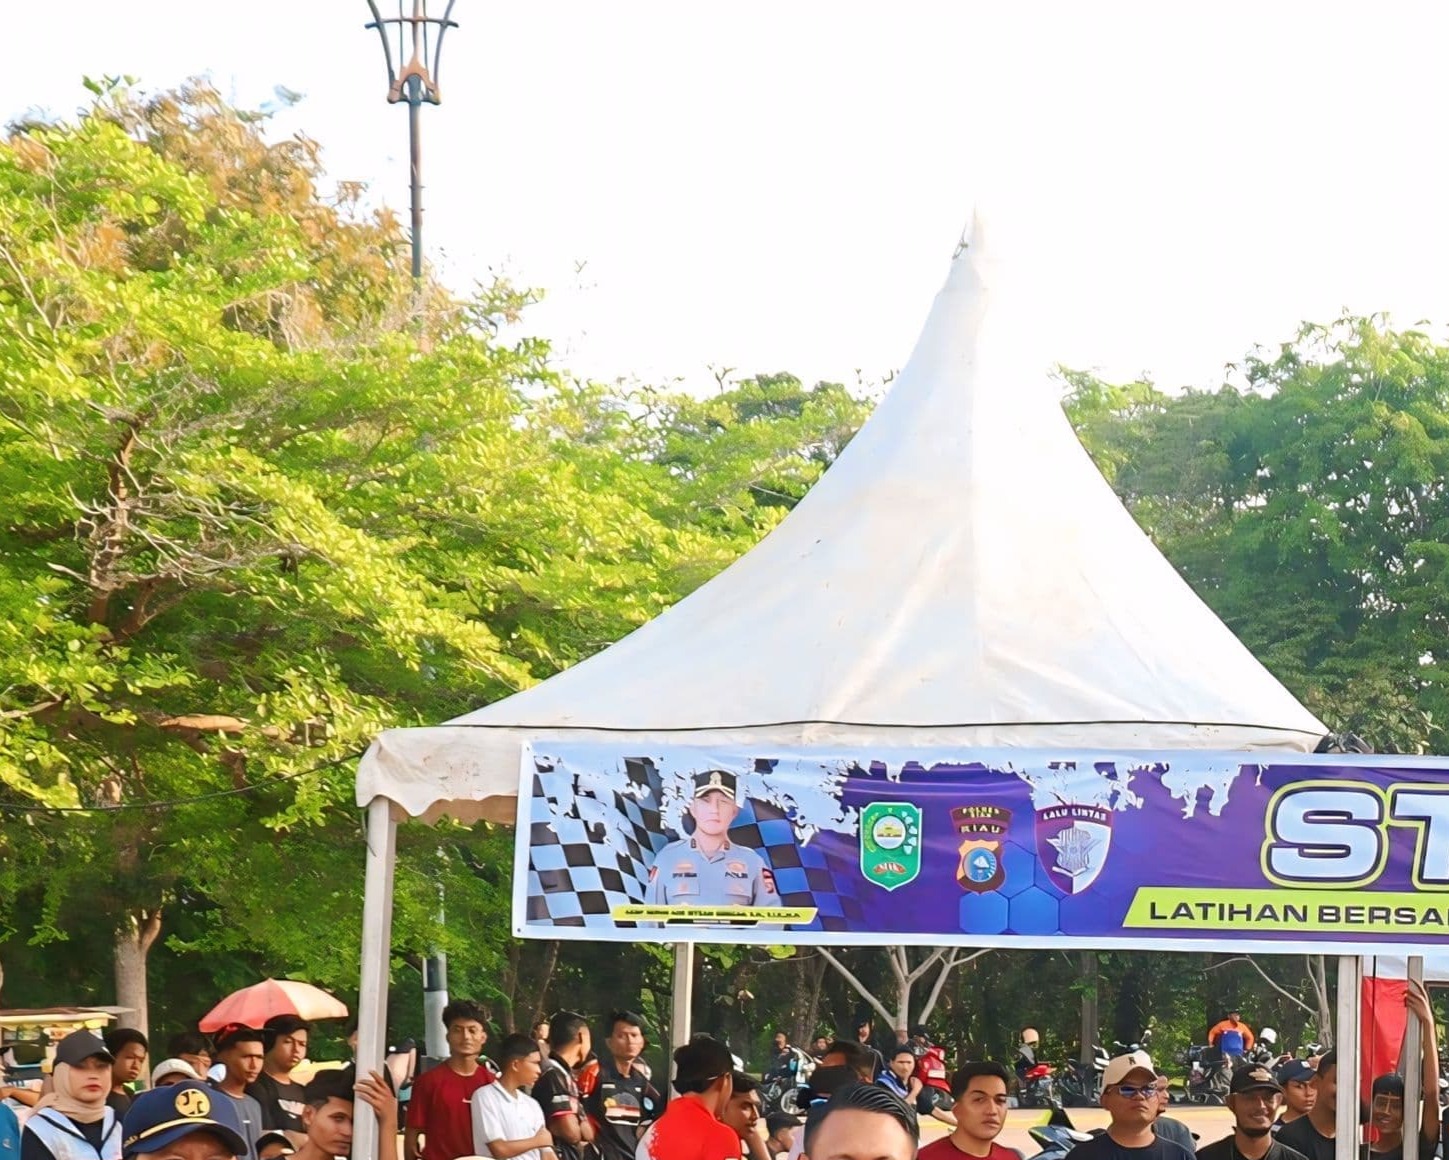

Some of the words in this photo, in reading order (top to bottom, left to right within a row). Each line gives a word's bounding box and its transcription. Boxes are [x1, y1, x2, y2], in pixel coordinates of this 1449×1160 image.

[1043, 807, 1068, 820] LALU
[1072, 807, 1107, 820] LINTAS
[960, 824, 1000, 834] RIAU
[1149, 901, 1308, 923] LATIHAN
